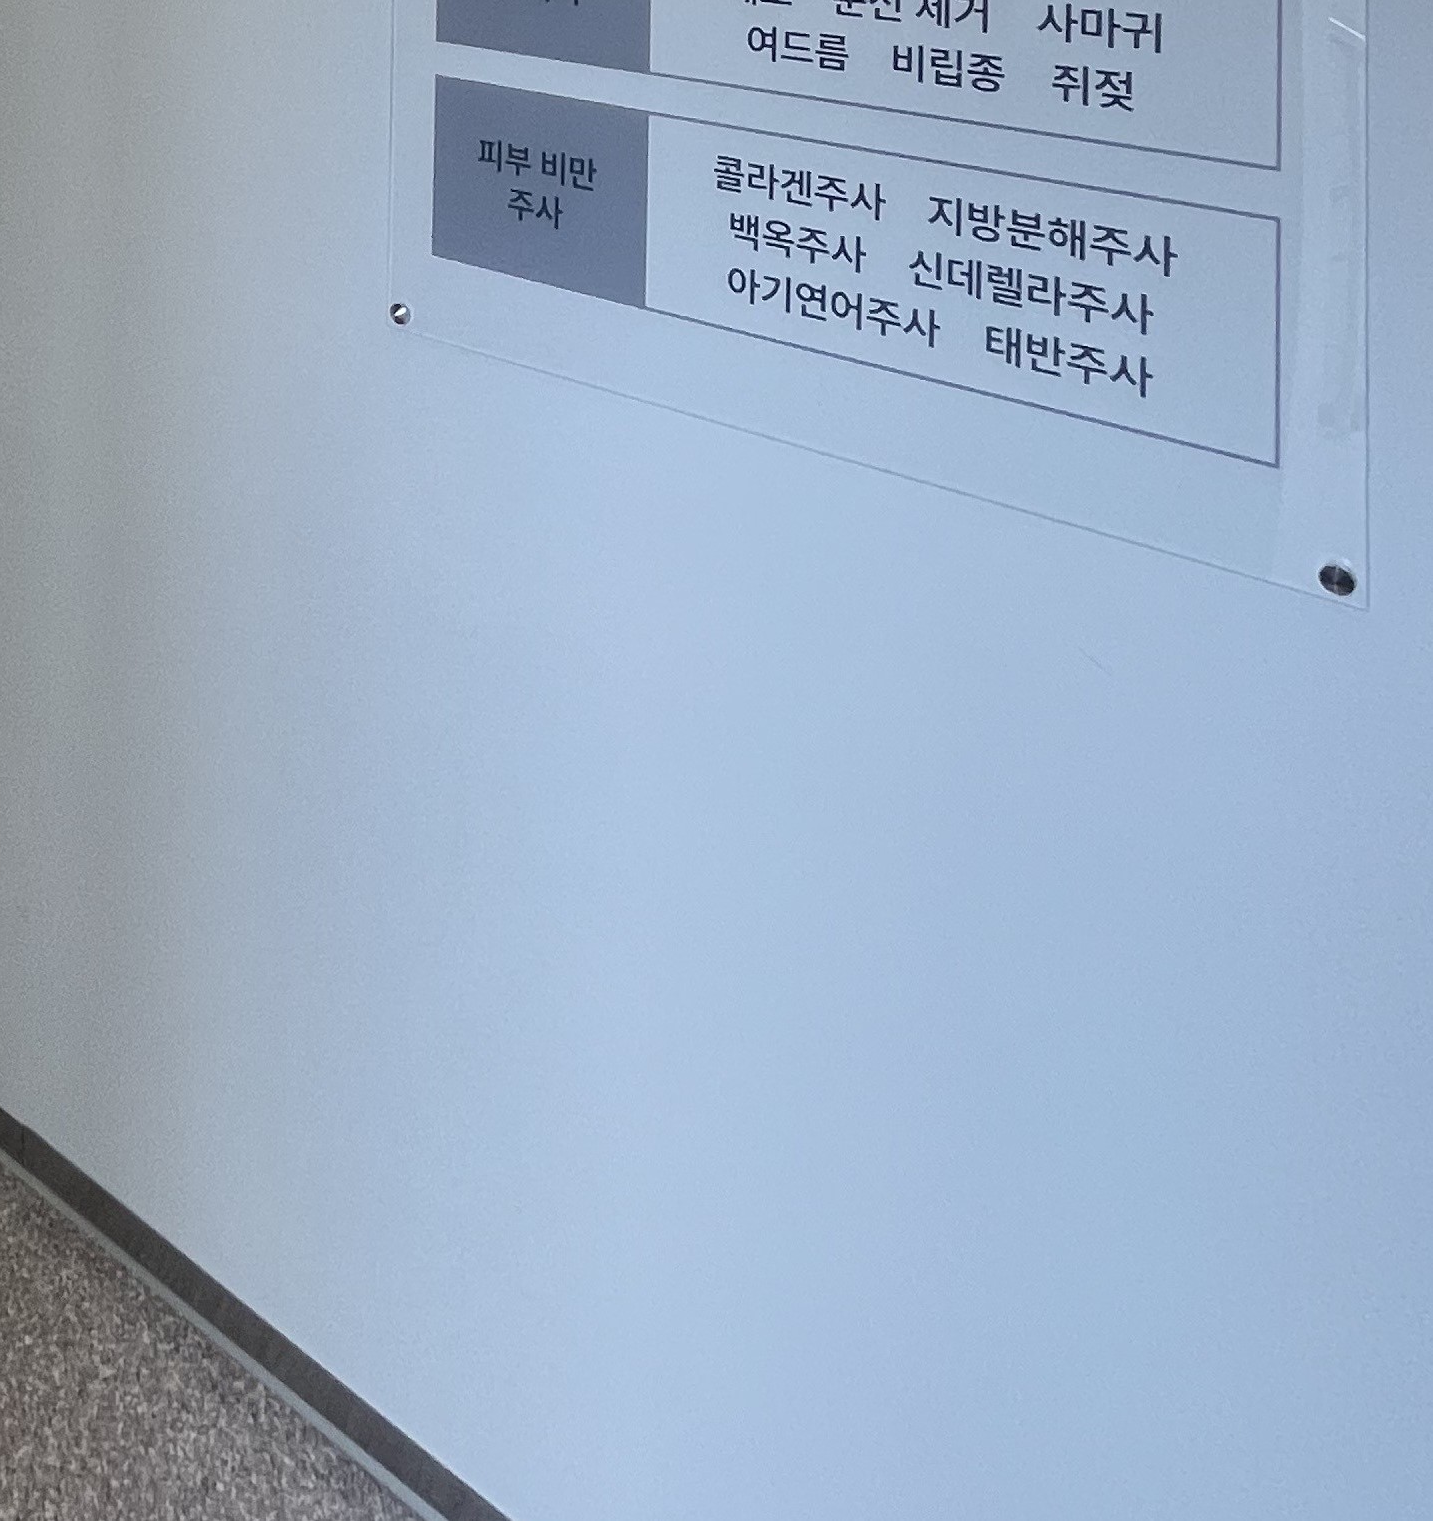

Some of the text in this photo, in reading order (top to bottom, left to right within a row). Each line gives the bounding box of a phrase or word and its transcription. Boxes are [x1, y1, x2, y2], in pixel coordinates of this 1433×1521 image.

[748, 26, 1134, 112] 여드름 비립종 쥐젖
[1036, 4, 1162, 53] 사마귀
[478, 140, 597, 191] 피부 비만
[508, 189, 564, 230] 주사
[713, 155, 1178, 280] 콜라겐주사 지방분해주사
[729, 213, 1154, 337] 백옥주사 신데렐라주사
[727, 267, 1153, 399] 아기연어주사 태반주사
